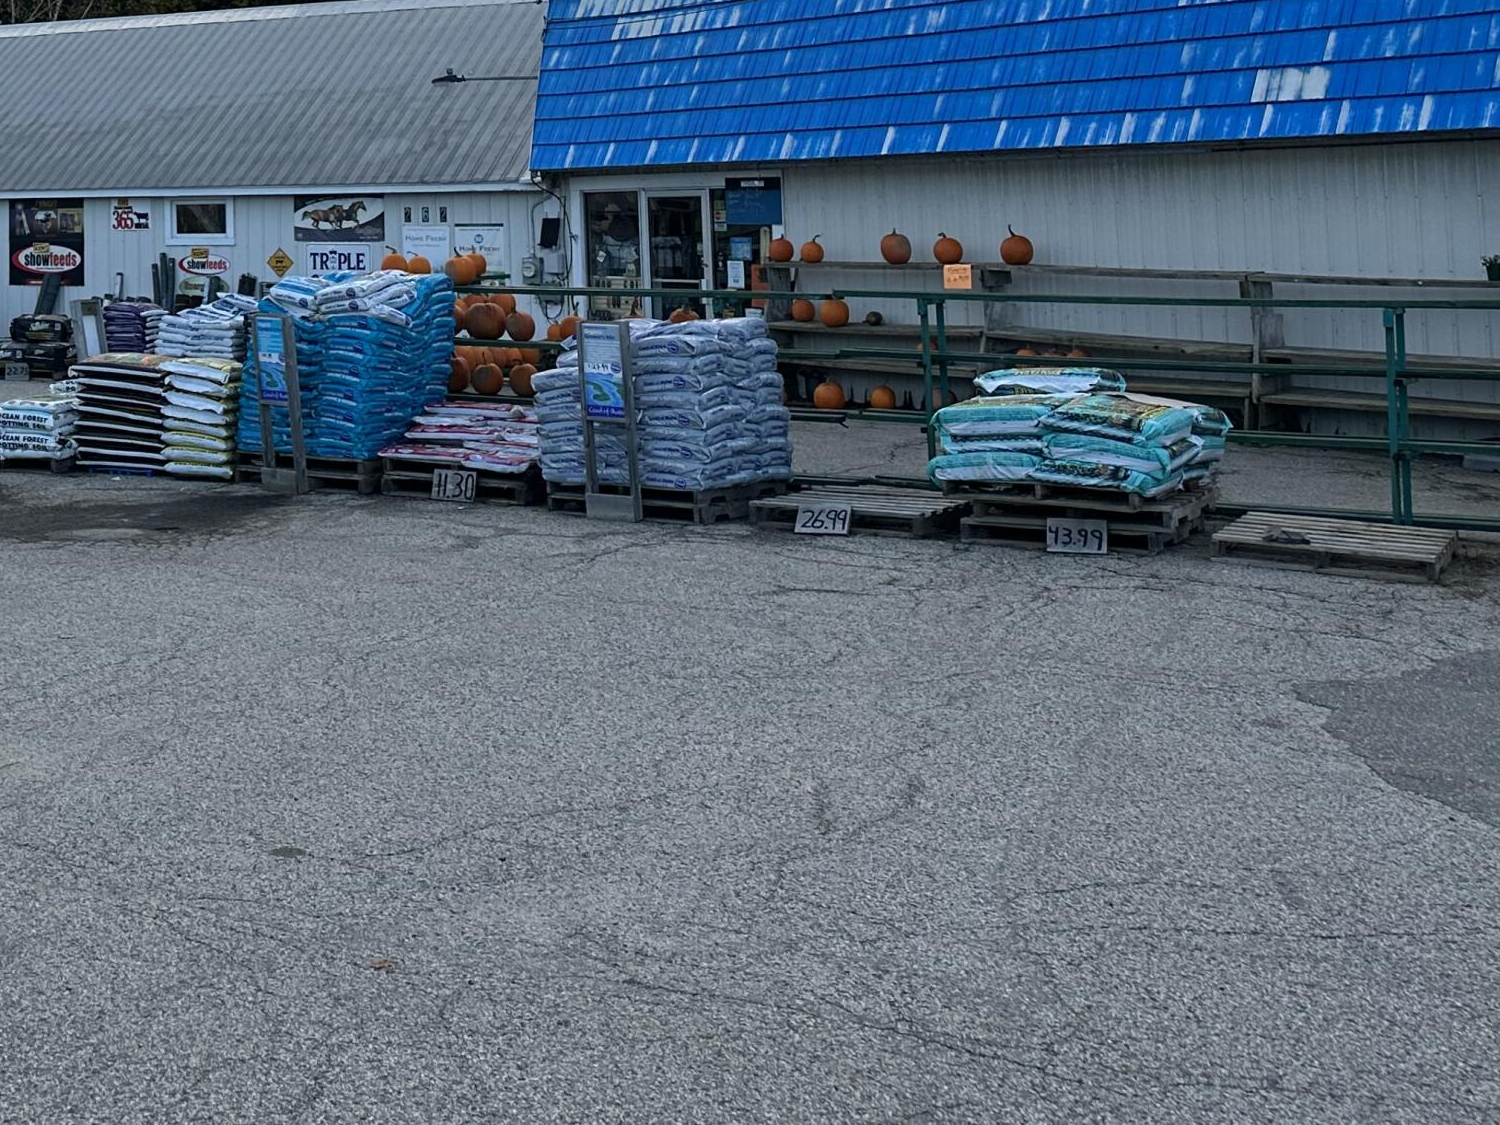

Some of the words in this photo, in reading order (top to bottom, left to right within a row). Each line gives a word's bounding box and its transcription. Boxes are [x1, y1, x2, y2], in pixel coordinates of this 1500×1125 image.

[112, 210, 134, 229] 365
[22, 414, 48, 423] FOREST
[22, 436, 49, 444] FOREST
[801, 509, 848, 530] 26.99
[1048, 526, 1103, 551] 43.99
